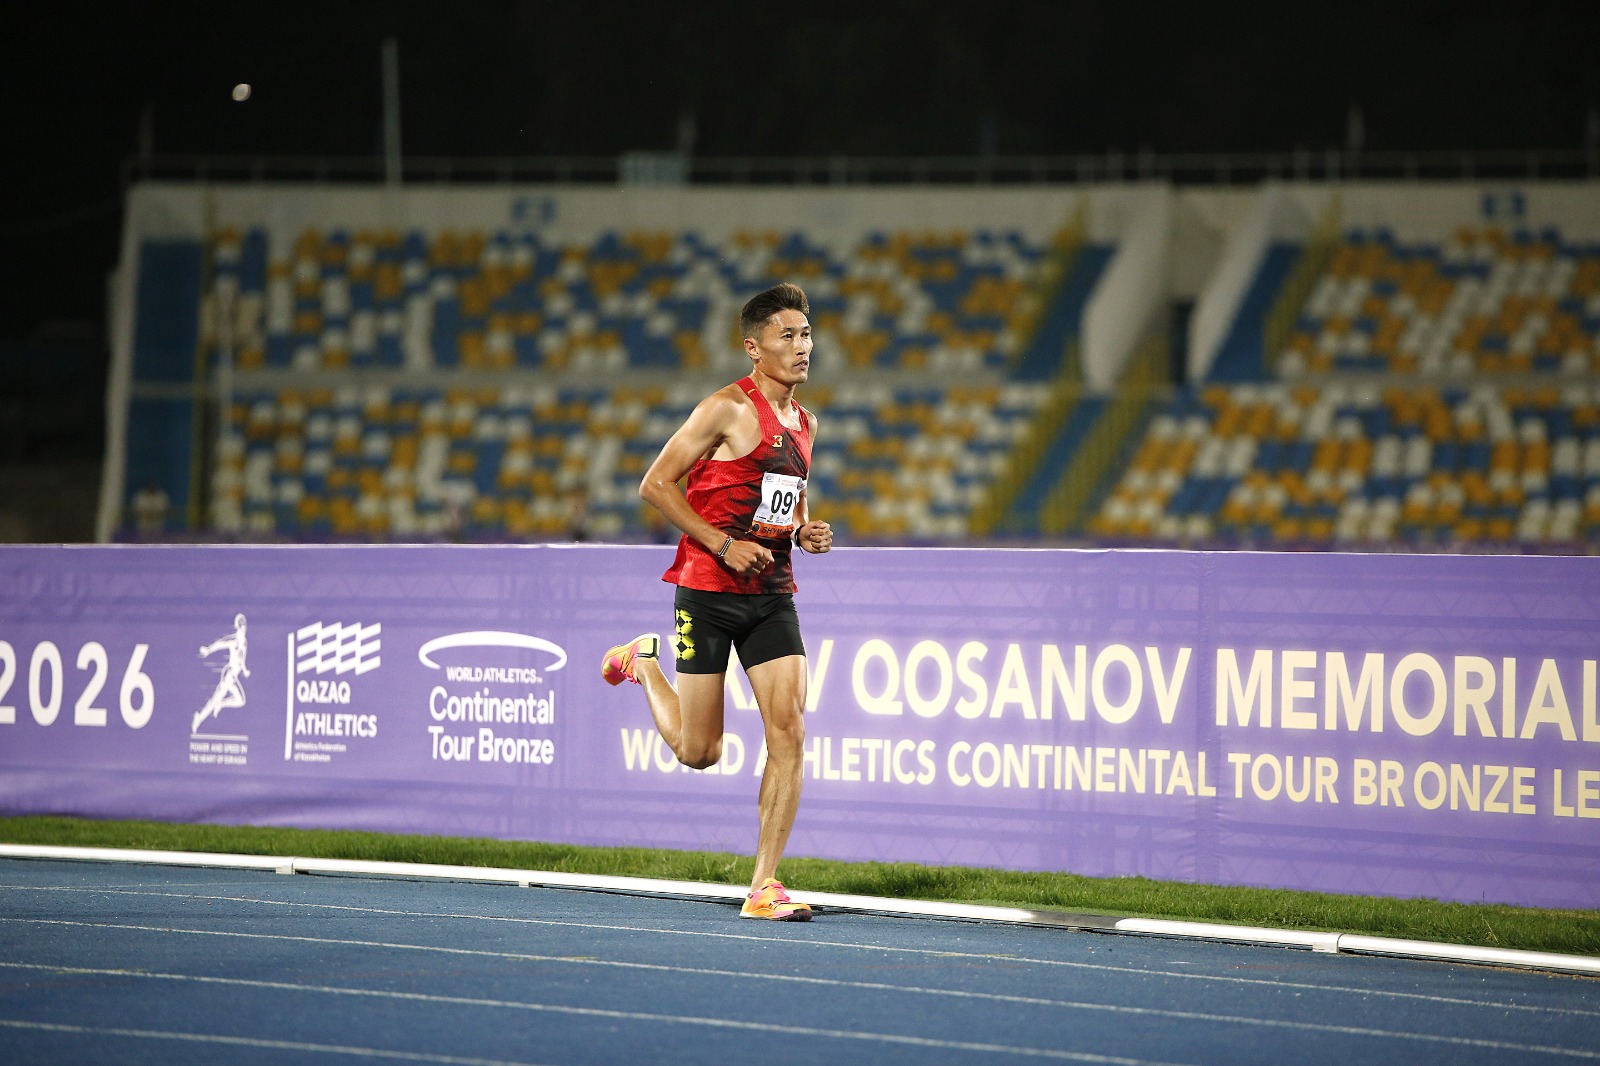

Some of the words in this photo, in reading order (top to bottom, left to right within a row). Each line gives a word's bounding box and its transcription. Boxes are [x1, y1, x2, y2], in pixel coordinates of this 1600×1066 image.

[0, 640, 154, 729] 2026
[297, 680, 351, 704] QAZAQ
[447, 667, 483, 682] WORLD
[483, 668, 537, 684] ATHLETICS
[852, 638, 1192, 724] QOSANOV
[1215, 648, 1600, 742] MEMORIAL
[295, 712, 377, 737] ATHLETICS
[429, 685, 554, 725] Continental
[428, 725, 475, 761] Tour
[478, 727, 555, 765] Bronze
[621, 728, 745, 775] WOD
[754, 732, 936, 785] HLETICS
[947, 741, 1216, 796] CONTINENTAL
[1228, 752, 1339, 803] TOUR
[1353, 758, 1536, 815] BRONZE
